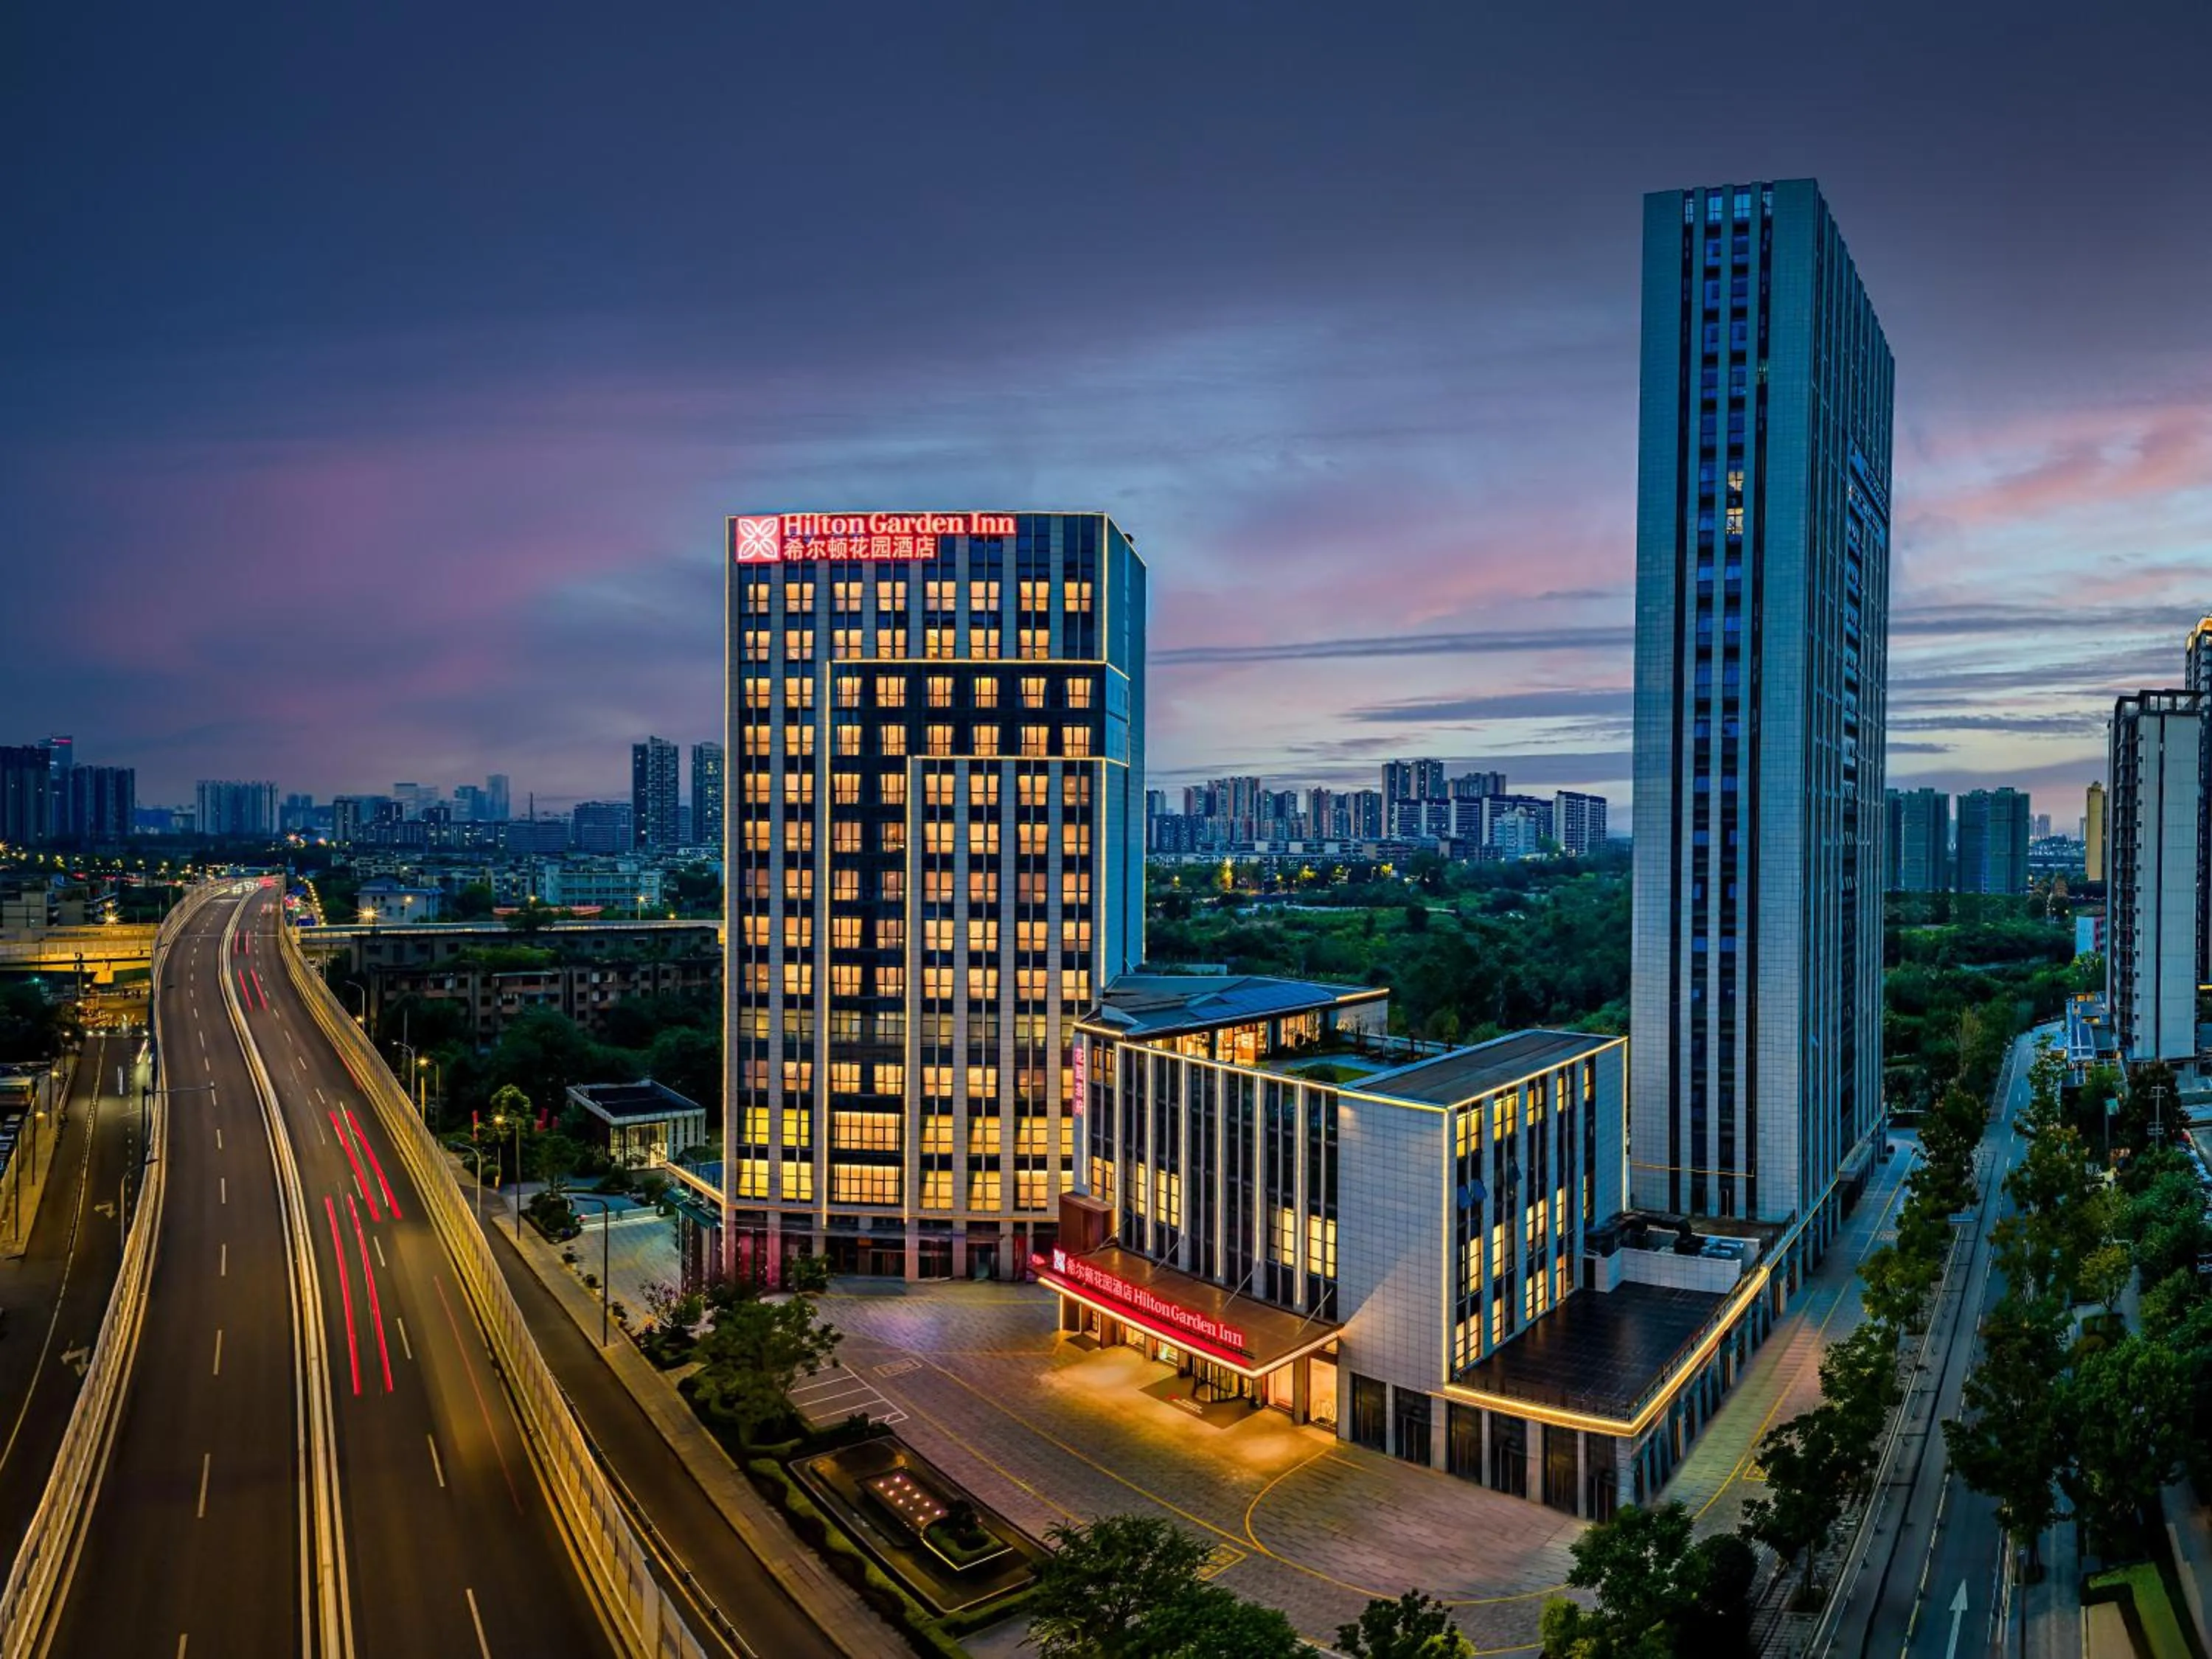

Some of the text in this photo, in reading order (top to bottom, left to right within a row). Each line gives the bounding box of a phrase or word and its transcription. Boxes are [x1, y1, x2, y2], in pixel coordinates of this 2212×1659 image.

[783, 513, 1015, 535] Hilton Garden Inn
[784, 537, 935, 560] 希尔顿花园酒店
[1133, 1288, 1170, 1317] Hilton
[1171, 1305, 1216, 1337] Garden
[1219, 1324, 1242, 1347] Inn
